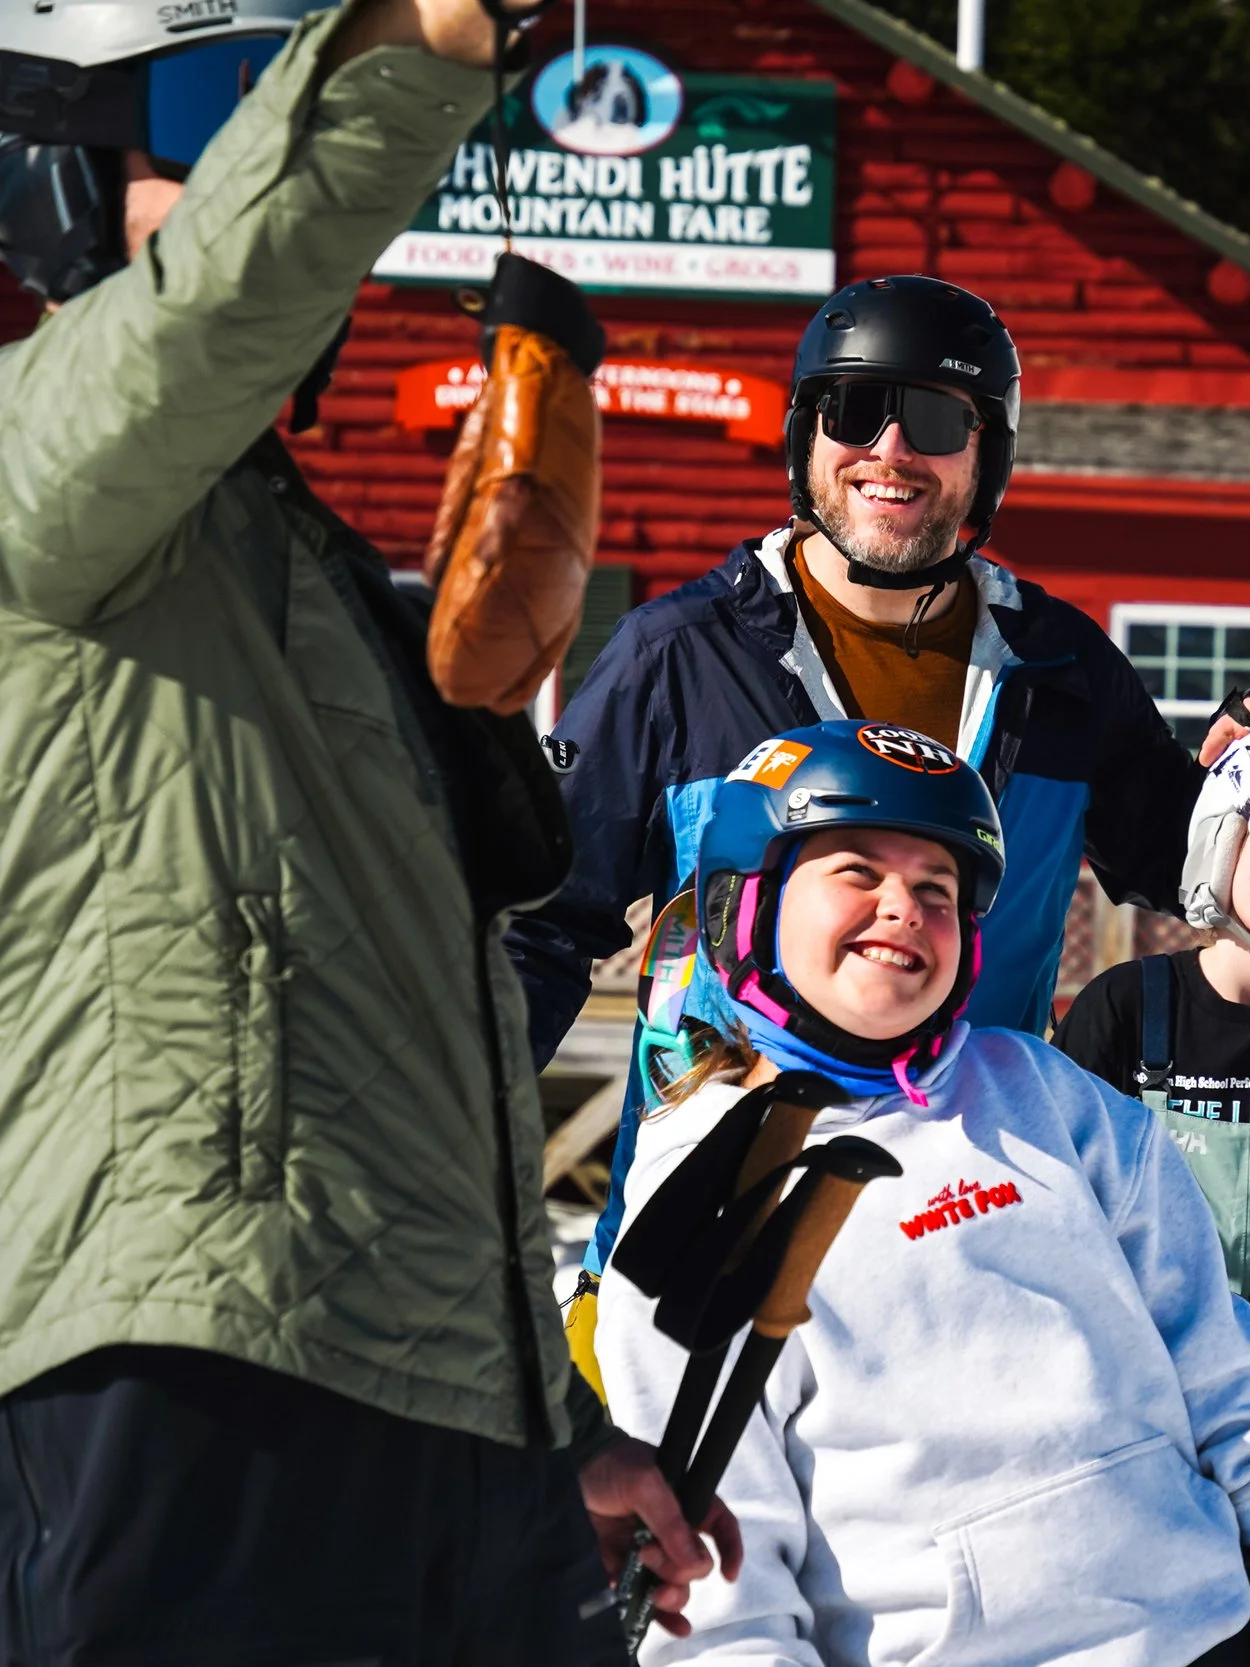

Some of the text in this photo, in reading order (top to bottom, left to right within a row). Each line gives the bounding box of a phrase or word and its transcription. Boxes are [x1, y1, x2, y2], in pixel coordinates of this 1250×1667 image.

[157, 0, 238, 24] SMITH
[438, 143, 813, 207] HWENDI HÜTTE
[437, 193, 773, 244] MOUNTAIN FARE
[406, 243, 487, 268] FOOD
[558, 740, 567, 767] LEKI
[870, 739, 954, 767] NH
[1175, 1075, 1197, 1091] High
[1198, 1076, 1229, 1089] School
[974, 1181, 1024, 1215] FOX
